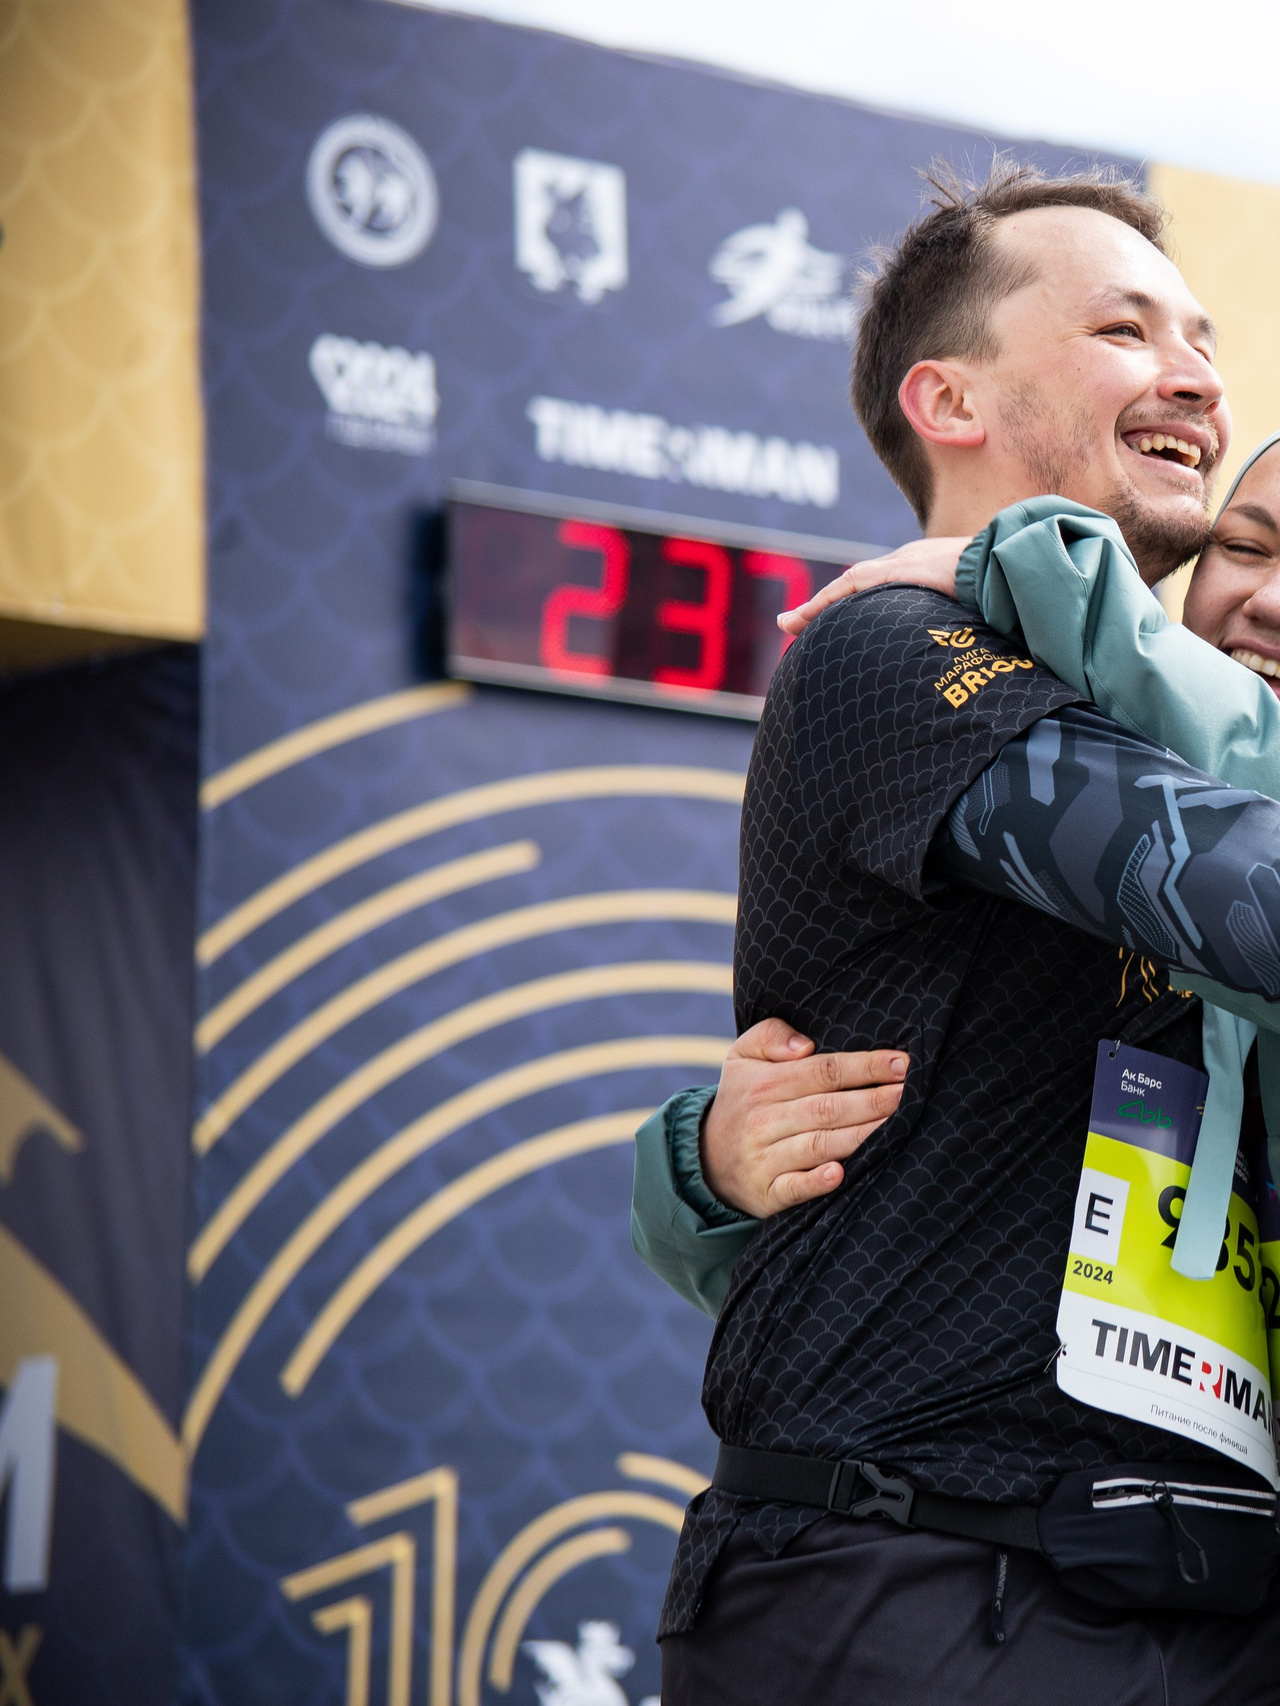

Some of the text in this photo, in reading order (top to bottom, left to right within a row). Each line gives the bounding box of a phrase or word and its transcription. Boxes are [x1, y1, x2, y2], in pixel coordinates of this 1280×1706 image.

[954, 647, 990, 664] ЛИГА
[1120, 1080, 1146, 1097] Банк
[1121, 1068, 1162, 1090] Ак Барс
[1072, 1260, 1114, 1285] 2024
[1091, 1318, 1273, 1436] TIMERMA
[1150, 1403, 1248, 1455] Питание после финиша
